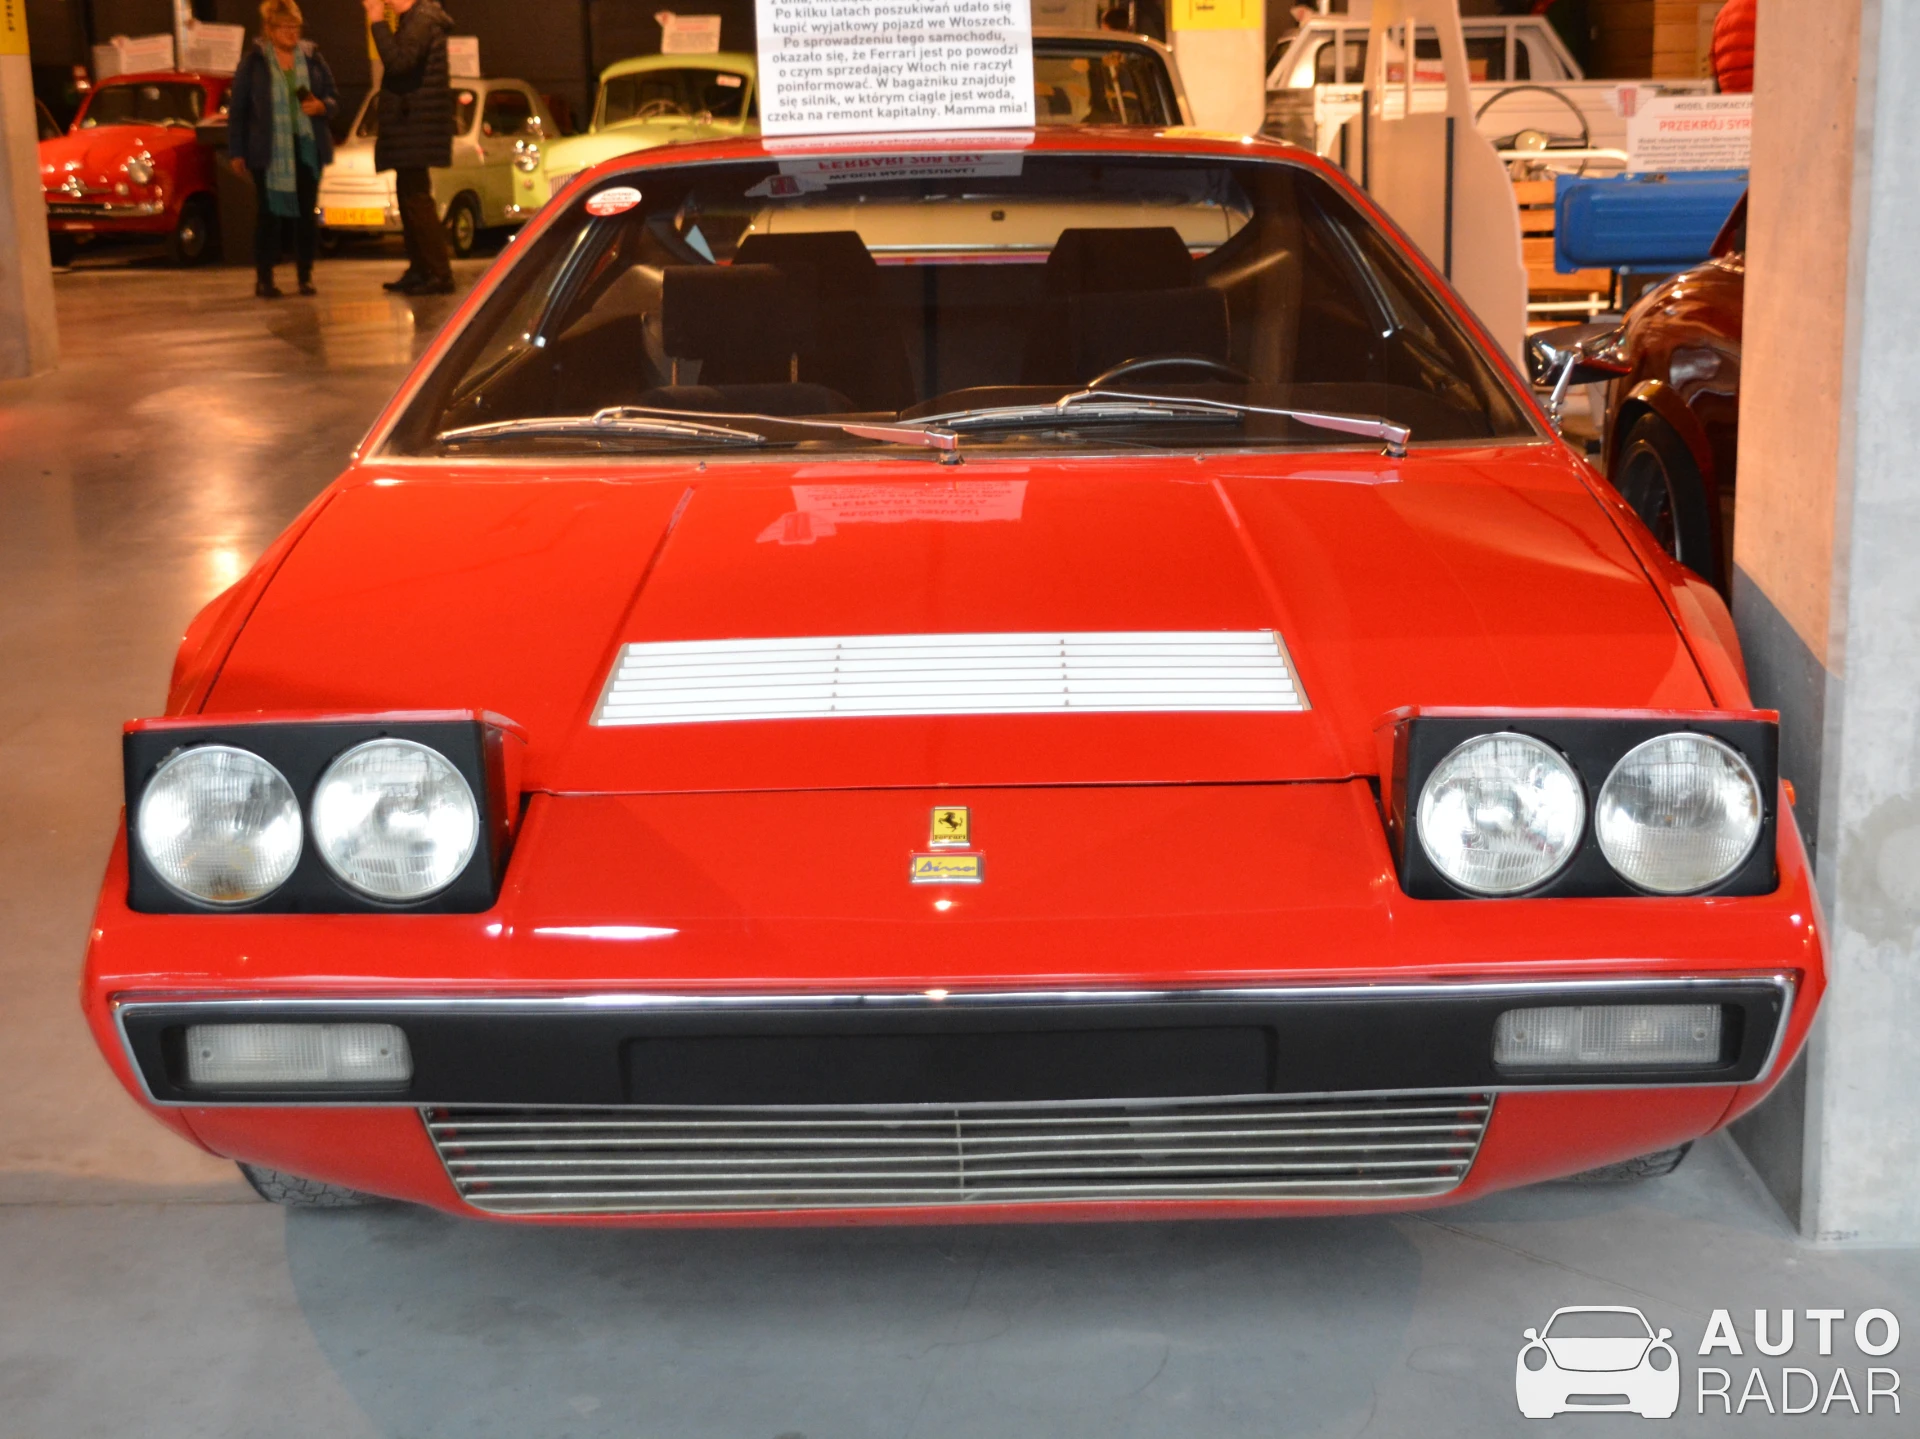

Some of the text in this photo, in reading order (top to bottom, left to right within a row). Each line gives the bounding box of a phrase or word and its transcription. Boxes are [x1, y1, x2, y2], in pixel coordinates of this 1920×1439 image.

[775, 2, 1012, 19] Po kilku latach poszukiwań udało się
[773, 22, 807, 35] kupić
[882, 18, 923, 31] pojazd
[927, 19, 945, 28] we
[949, 16, 1015, 28] Włoszech.
[783, 31, 1006, 49] Po sprowadzeniu tego samochodu,
[772, 44, 1019, 63] okazało się, że Ferrari jest po powodzi
[779, 59, 1013, 79] o czym sprzedający Włoch nie raczył
[777, 74, 1016, 94] poinformować. W bagażniku znajduje
[779, 88, 1015, 108] się silnik, w którym ciągle jest woda,
[767, 101, 1028, 122] czeka na remont kapitalny. Mamma mia!
[1659, 116, 1724, 132] PRZEKRÓJ
